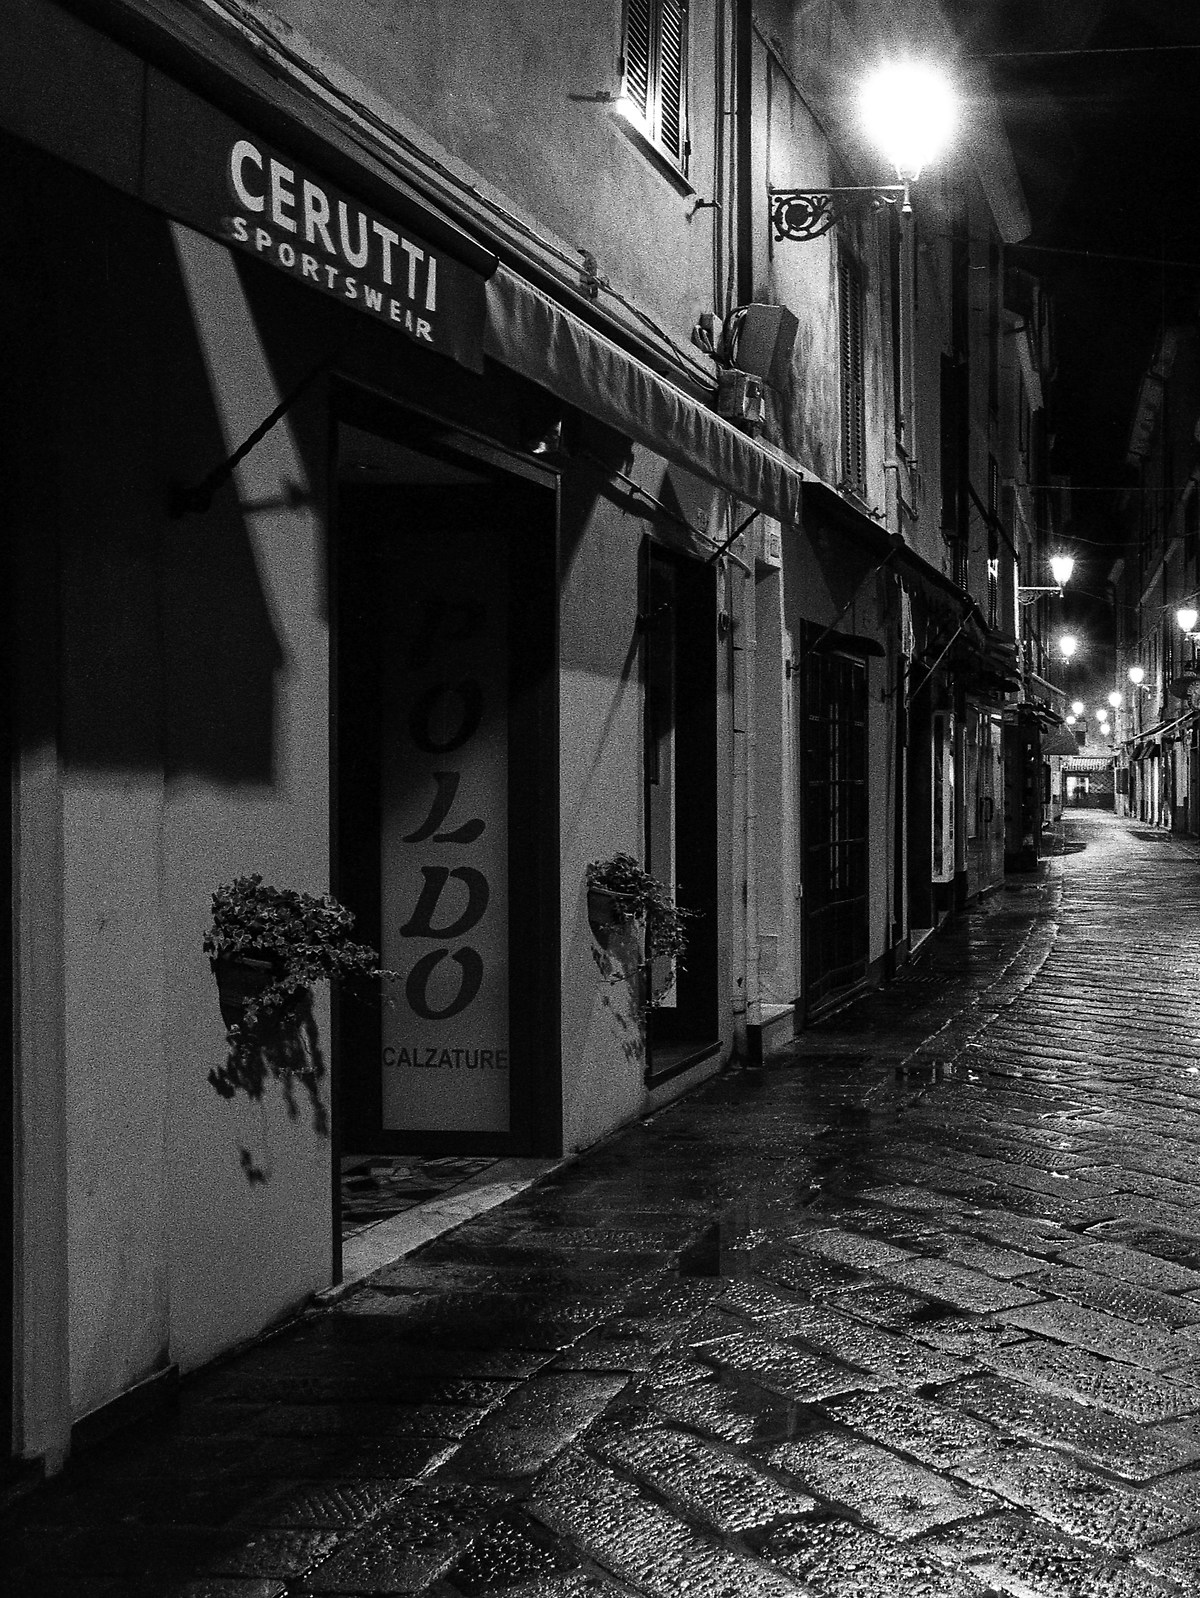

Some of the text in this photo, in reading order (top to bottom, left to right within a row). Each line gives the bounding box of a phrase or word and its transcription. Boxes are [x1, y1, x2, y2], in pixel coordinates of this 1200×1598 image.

[231, 140, 437, 311] CERUTTI
[231, 216, 435, 343] SPORTSWEAR
[398, 595, 492, 1021] POLDO
[382, 1046, 509, 1071] CALZATURE
